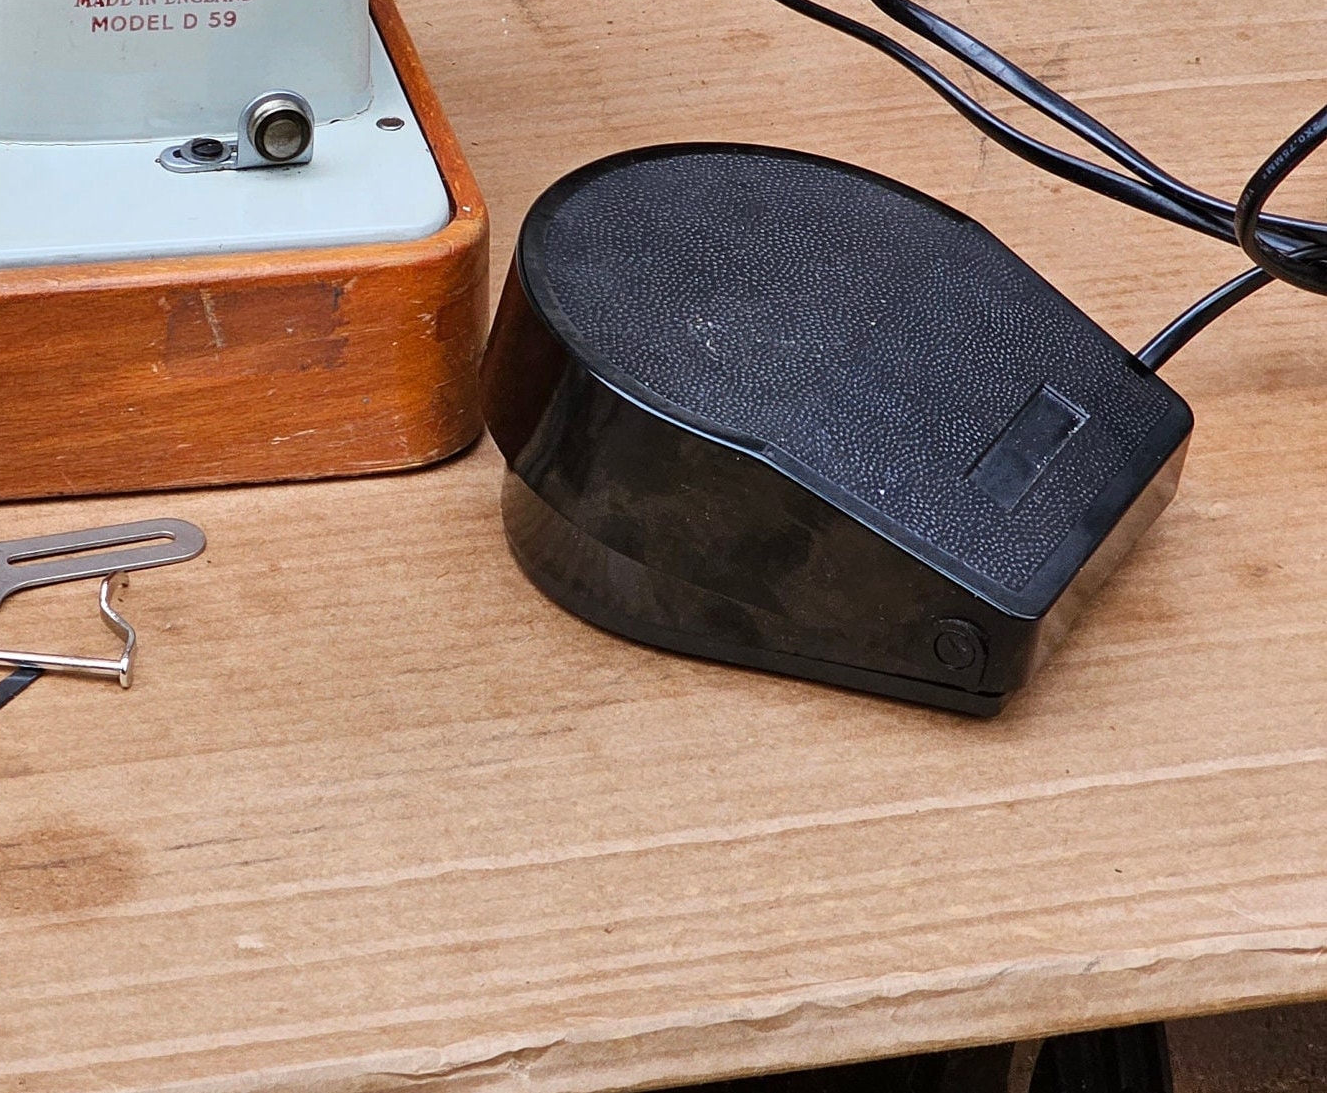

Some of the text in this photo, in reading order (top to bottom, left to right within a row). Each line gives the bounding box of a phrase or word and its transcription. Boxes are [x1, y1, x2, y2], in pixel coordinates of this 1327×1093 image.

[91, 10, 237, 33] MODEL D 59
